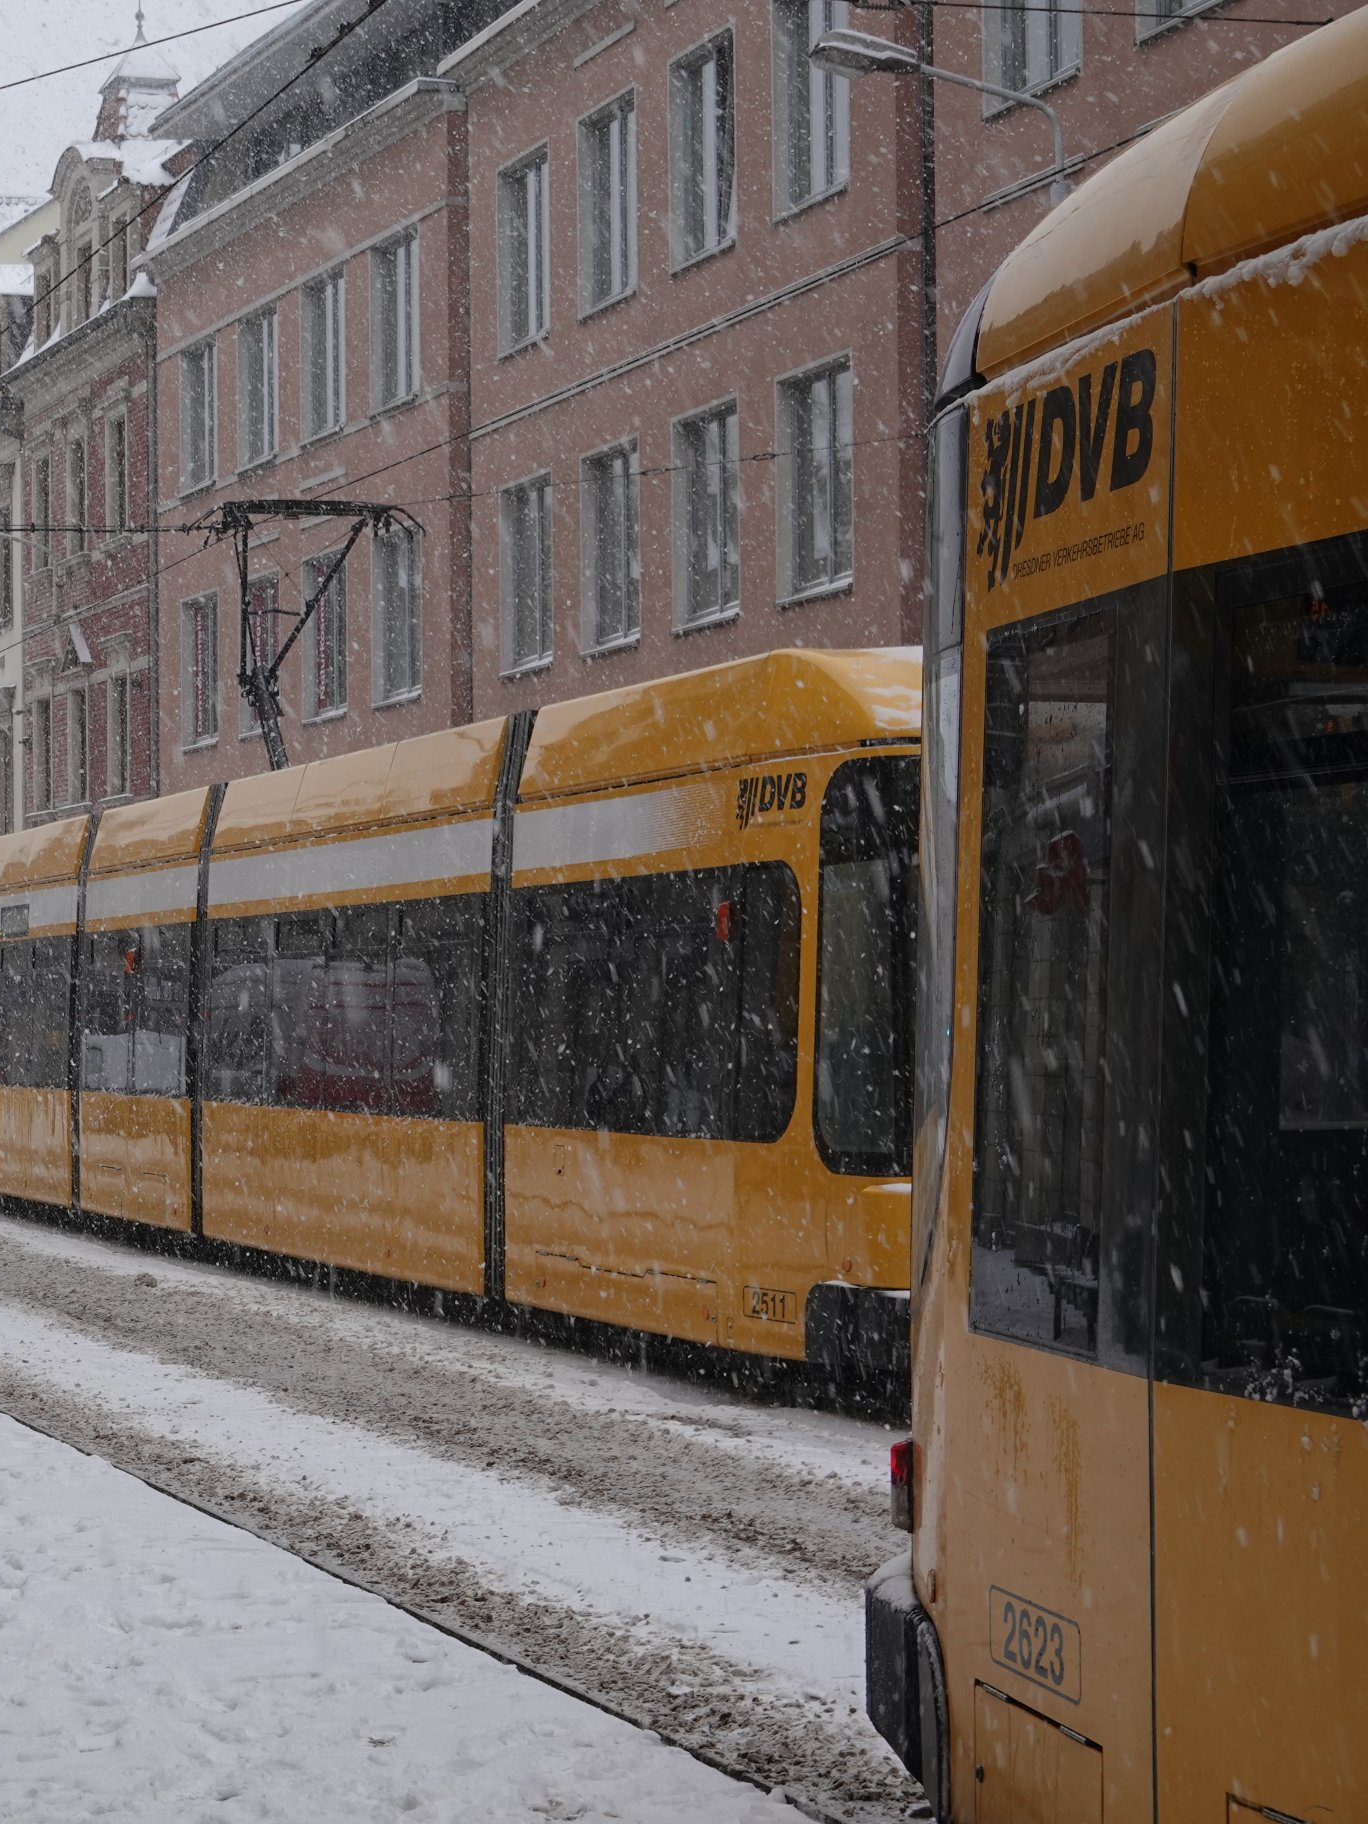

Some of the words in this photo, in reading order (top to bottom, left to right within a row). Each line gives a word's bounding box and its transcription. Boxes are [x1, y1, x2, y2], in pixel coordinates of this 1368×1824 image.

[1033, 348, 1157, 519] DVB
[1012, 552, 1051, 579] DRESDNER
[1053, 527, 1131, 567] VERKEHRSBETRIEBE
[1132, 522, 1145, 543] AG
[758, 772, 807, 812] DVB
[752, 1290, 786, 1319] 2511
[1003, 1601, 1065, 1686] 2623
